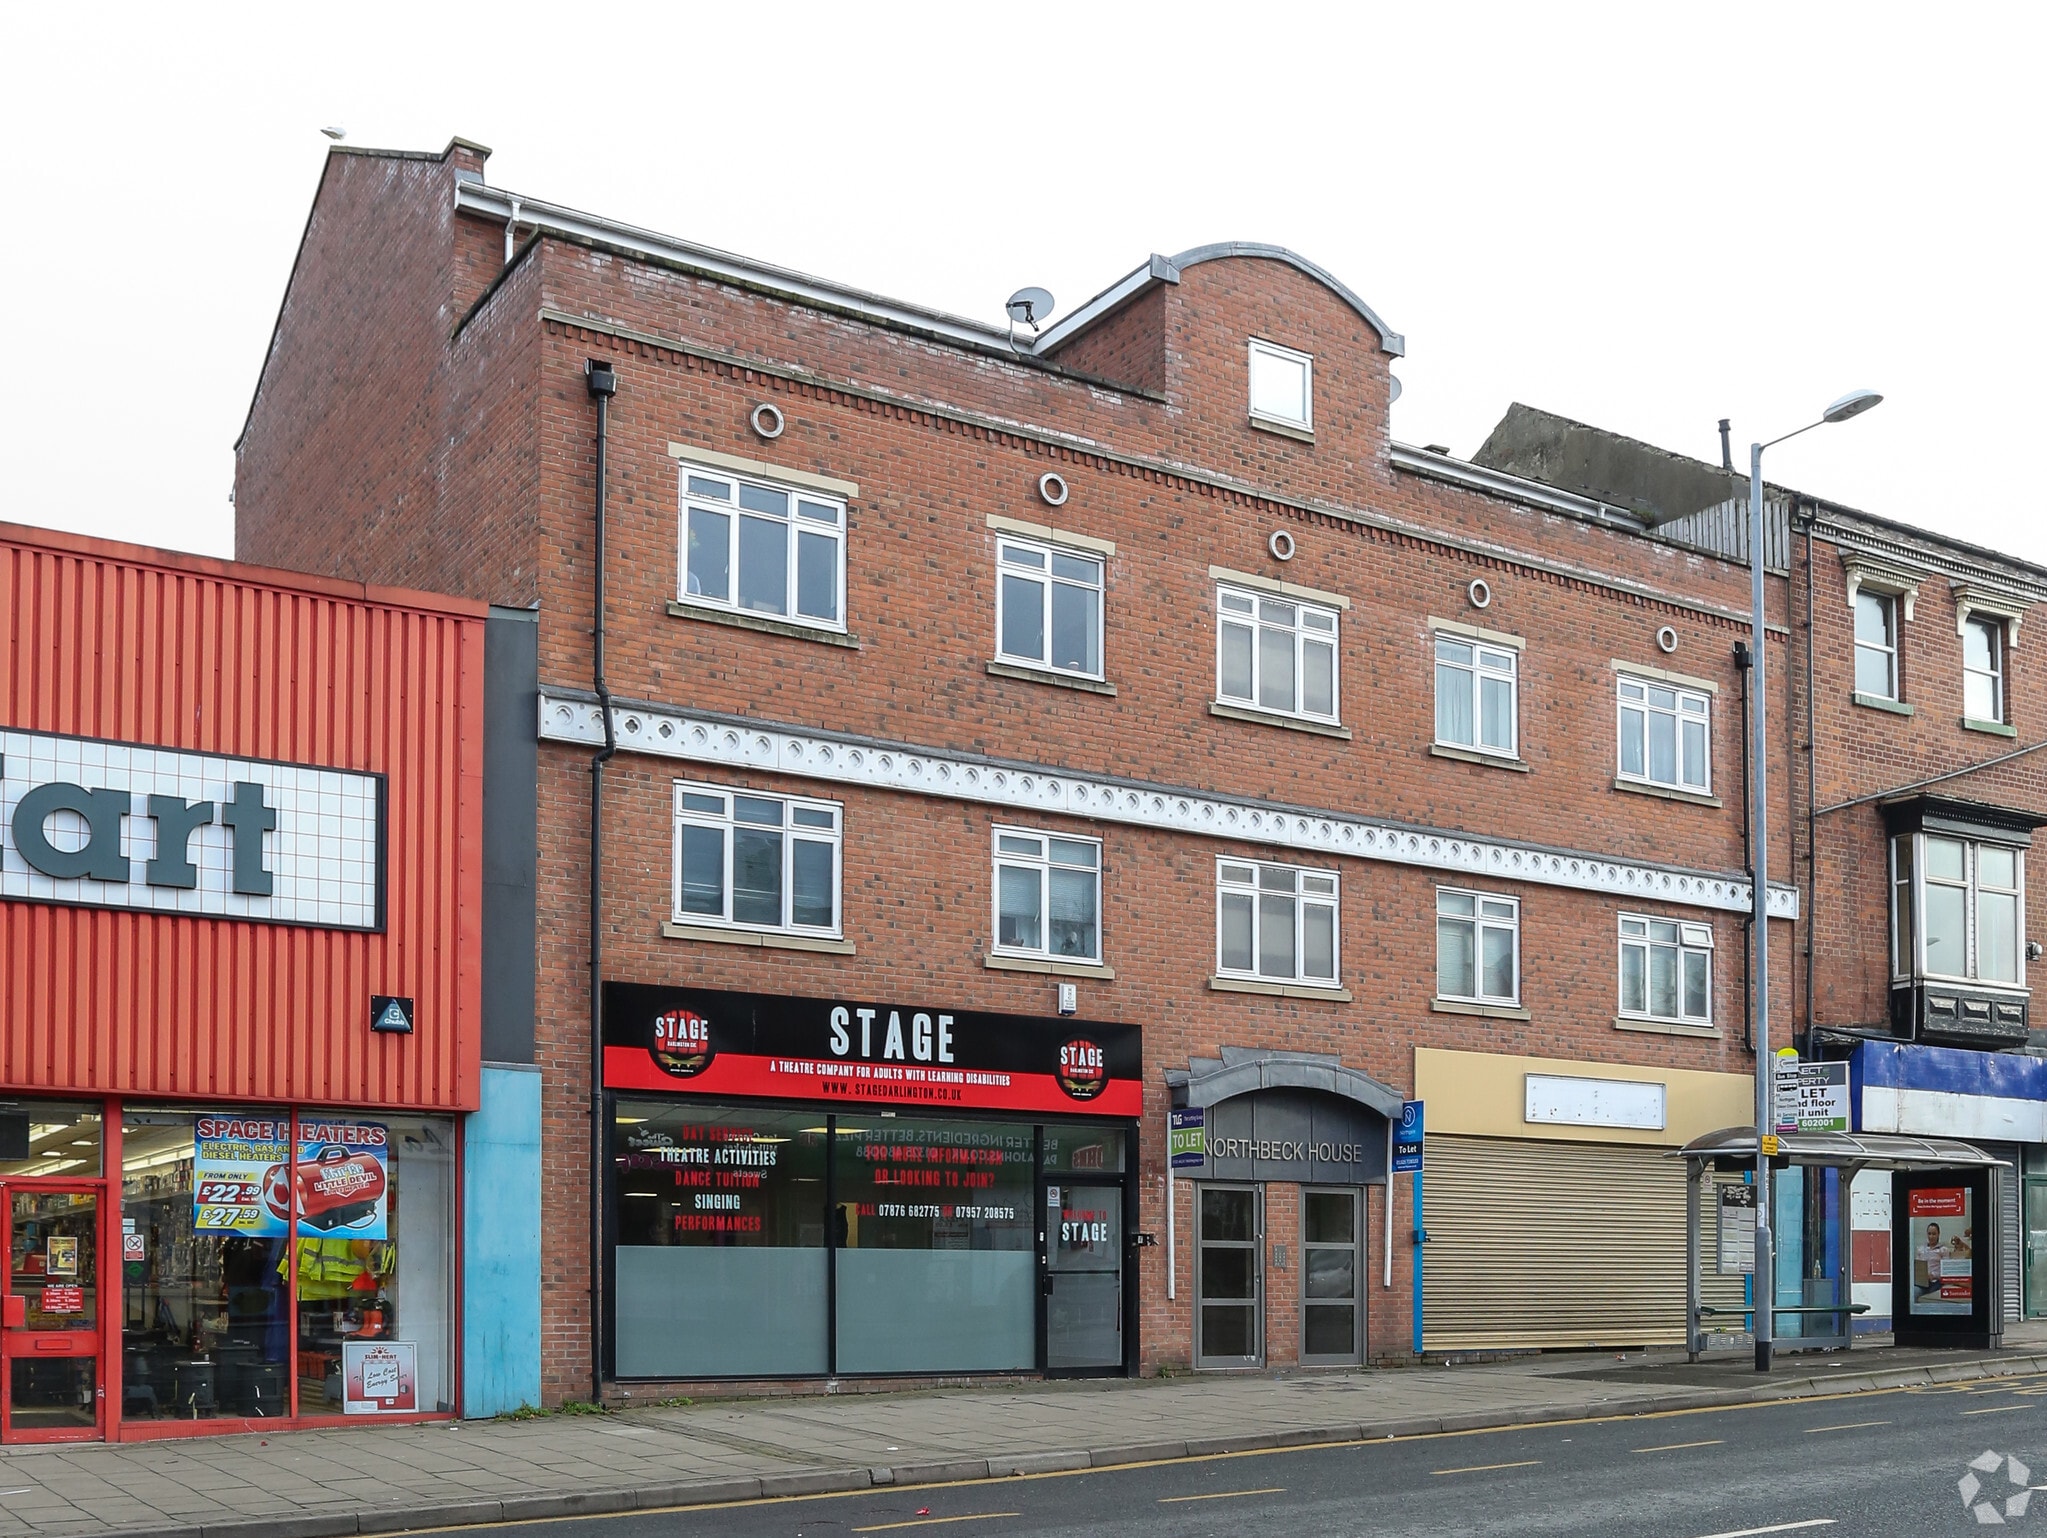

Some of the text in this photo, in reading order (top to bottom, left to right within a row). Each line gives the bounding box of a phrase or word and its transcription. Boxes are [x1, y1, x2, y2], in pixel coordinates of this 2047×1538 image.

[0, 753, 277, 896] art
[384, 1017, 405, 1026] Chubb
[655, 1016, 709, 1041] STAGE
[829, 1005, 954, 1063] STAGE
[1060, 1046, 1103, 1068] STAGE
[770, 1061, 1011, 1087] A THEATRE COMPANY FOR ADULTS WITH LEARNING DISABILITIES
[854, 1083, 962, 1101] STAGEDARLINGTON.CO.UK
[1801, 1088, 1827, 1098] LET
[1811, 1099, 1836, 1107] floor
[1172, 1114, 1183, 1126] TLG
[1808, 1108, 1829, 1117] unit
[1802, 1119, 1834, 1127] 602001
[197, 1118, 387, 1146] SPACE HEATERS
[682, 1124, 704, 1141] DAY
[1172, 1132, 1202, 1149] TO LET
[202, 1141, 305, 1154] ELECTRIC, GAS AND
[865, 1144, 1003, 1166] FOR MORE INFORMATION
[1204, 1137, 1363, 1163] NORTHBECK HOUSE
[1398, 1145, 1417, 1154] To Let
[202, 1151, 283, 1162] DIESEL HEATERS
[660, 1146, 710, 1164] THEATRE
[713, 1148, 777, 1167] ACTIVITIES
[314, 1171, 377, 1191] LITTLE DEVIL
[675, 1171, 760, 1189] DANCE TUITION
[874, 1168, 995, 1189] OR LOOKING TO JOIN?
[201, 1184, 261, 1203] £22.99
[694, 1193, 741, 1210] SINGING
[201, 1207, 260, 1226] £27.59
[855, 1203, 1015, 1220] CALL 07876 682775 OR 07957 208575
[1062, 1209, 1107, 1221] WELCOME TO
[674, 1215, 762, 1232] PERFORMANCES
[1061, 1222, 1107, 1242] STAGE
[367, 1371, 381, 1380] Low
[382, 1366, 397, 1376] Cost
[366, 1379, 388, 1389] Energy
